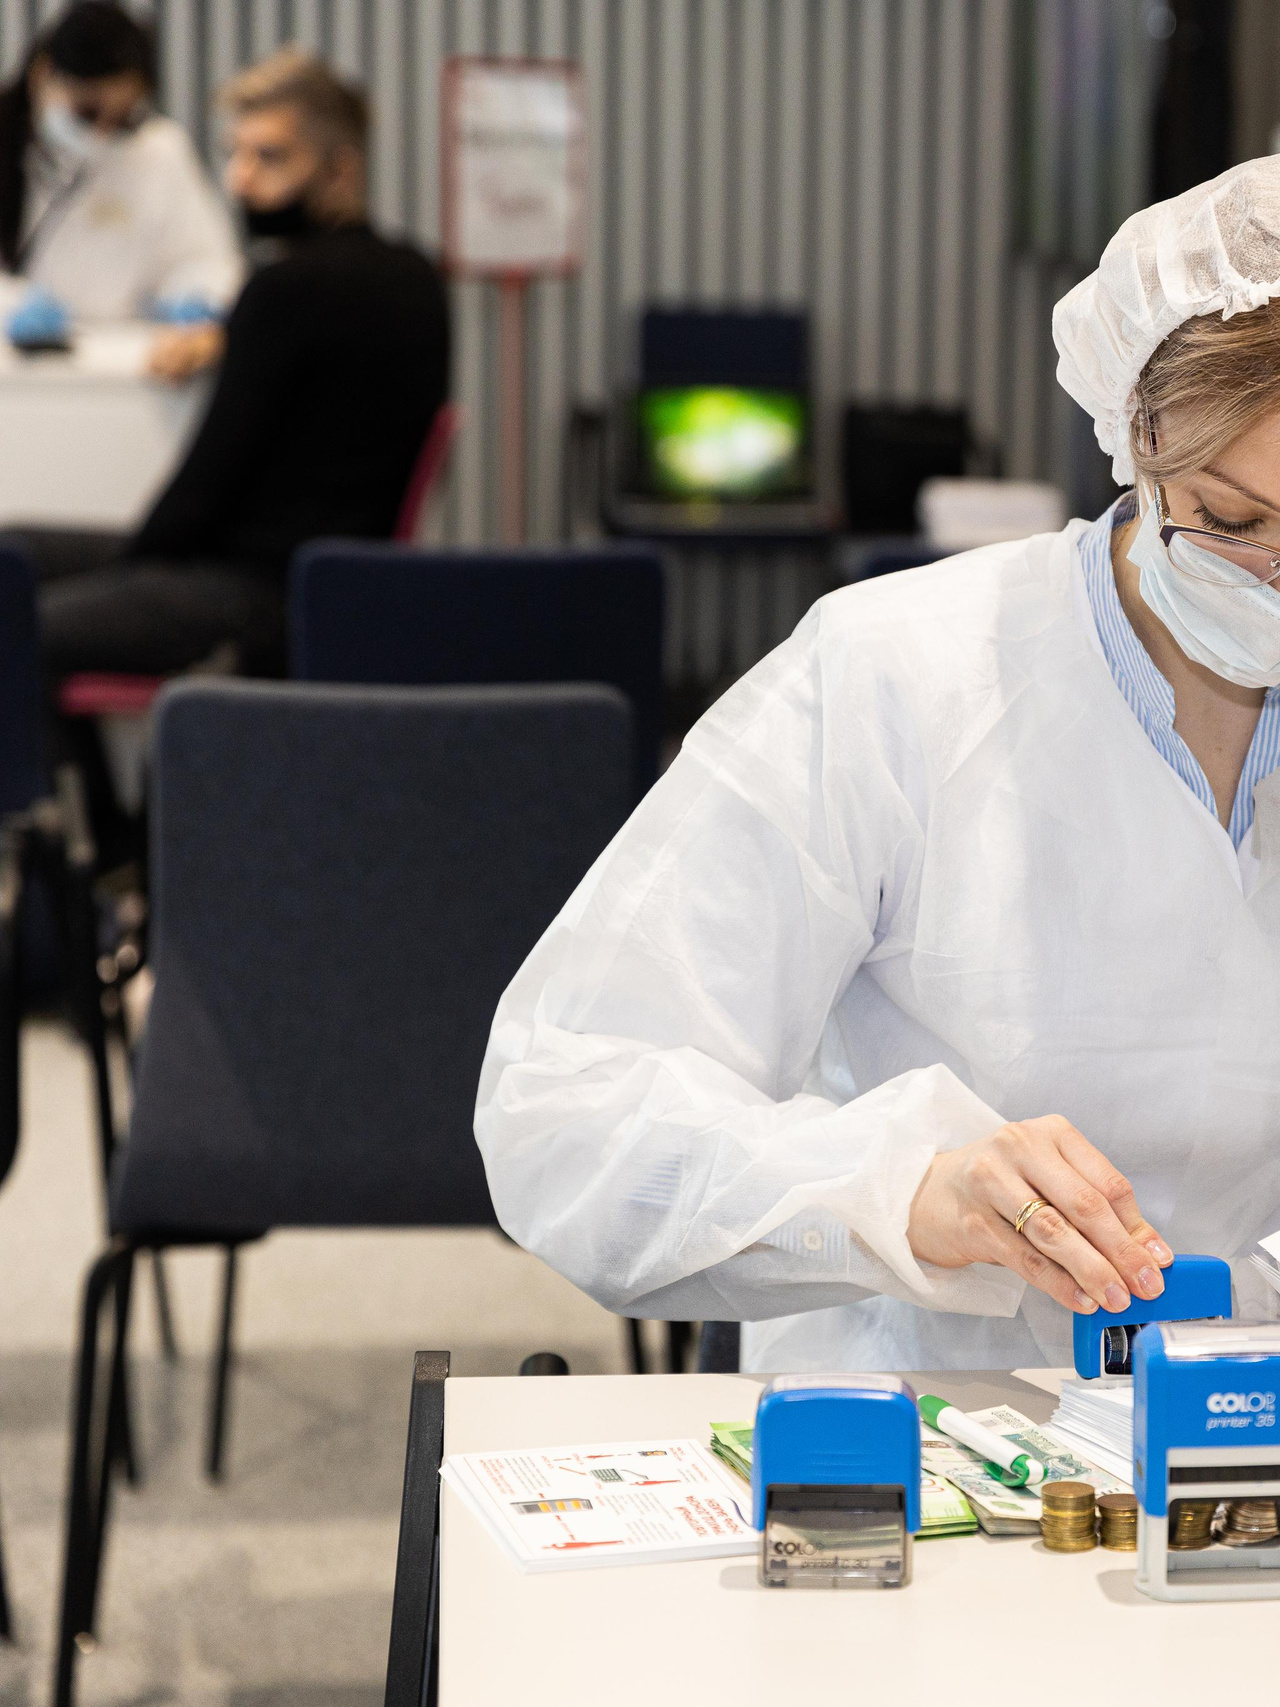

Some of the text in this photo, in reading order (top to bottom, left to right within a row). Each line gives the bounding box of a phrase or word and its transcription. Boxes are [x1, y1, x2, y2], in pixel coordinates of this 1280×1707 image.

[1206, 1391, 1276, 1413] COLOP
[1206, 1412, 1276, 1431] printer 35
[774, 1541, 821, 1556] COLO
